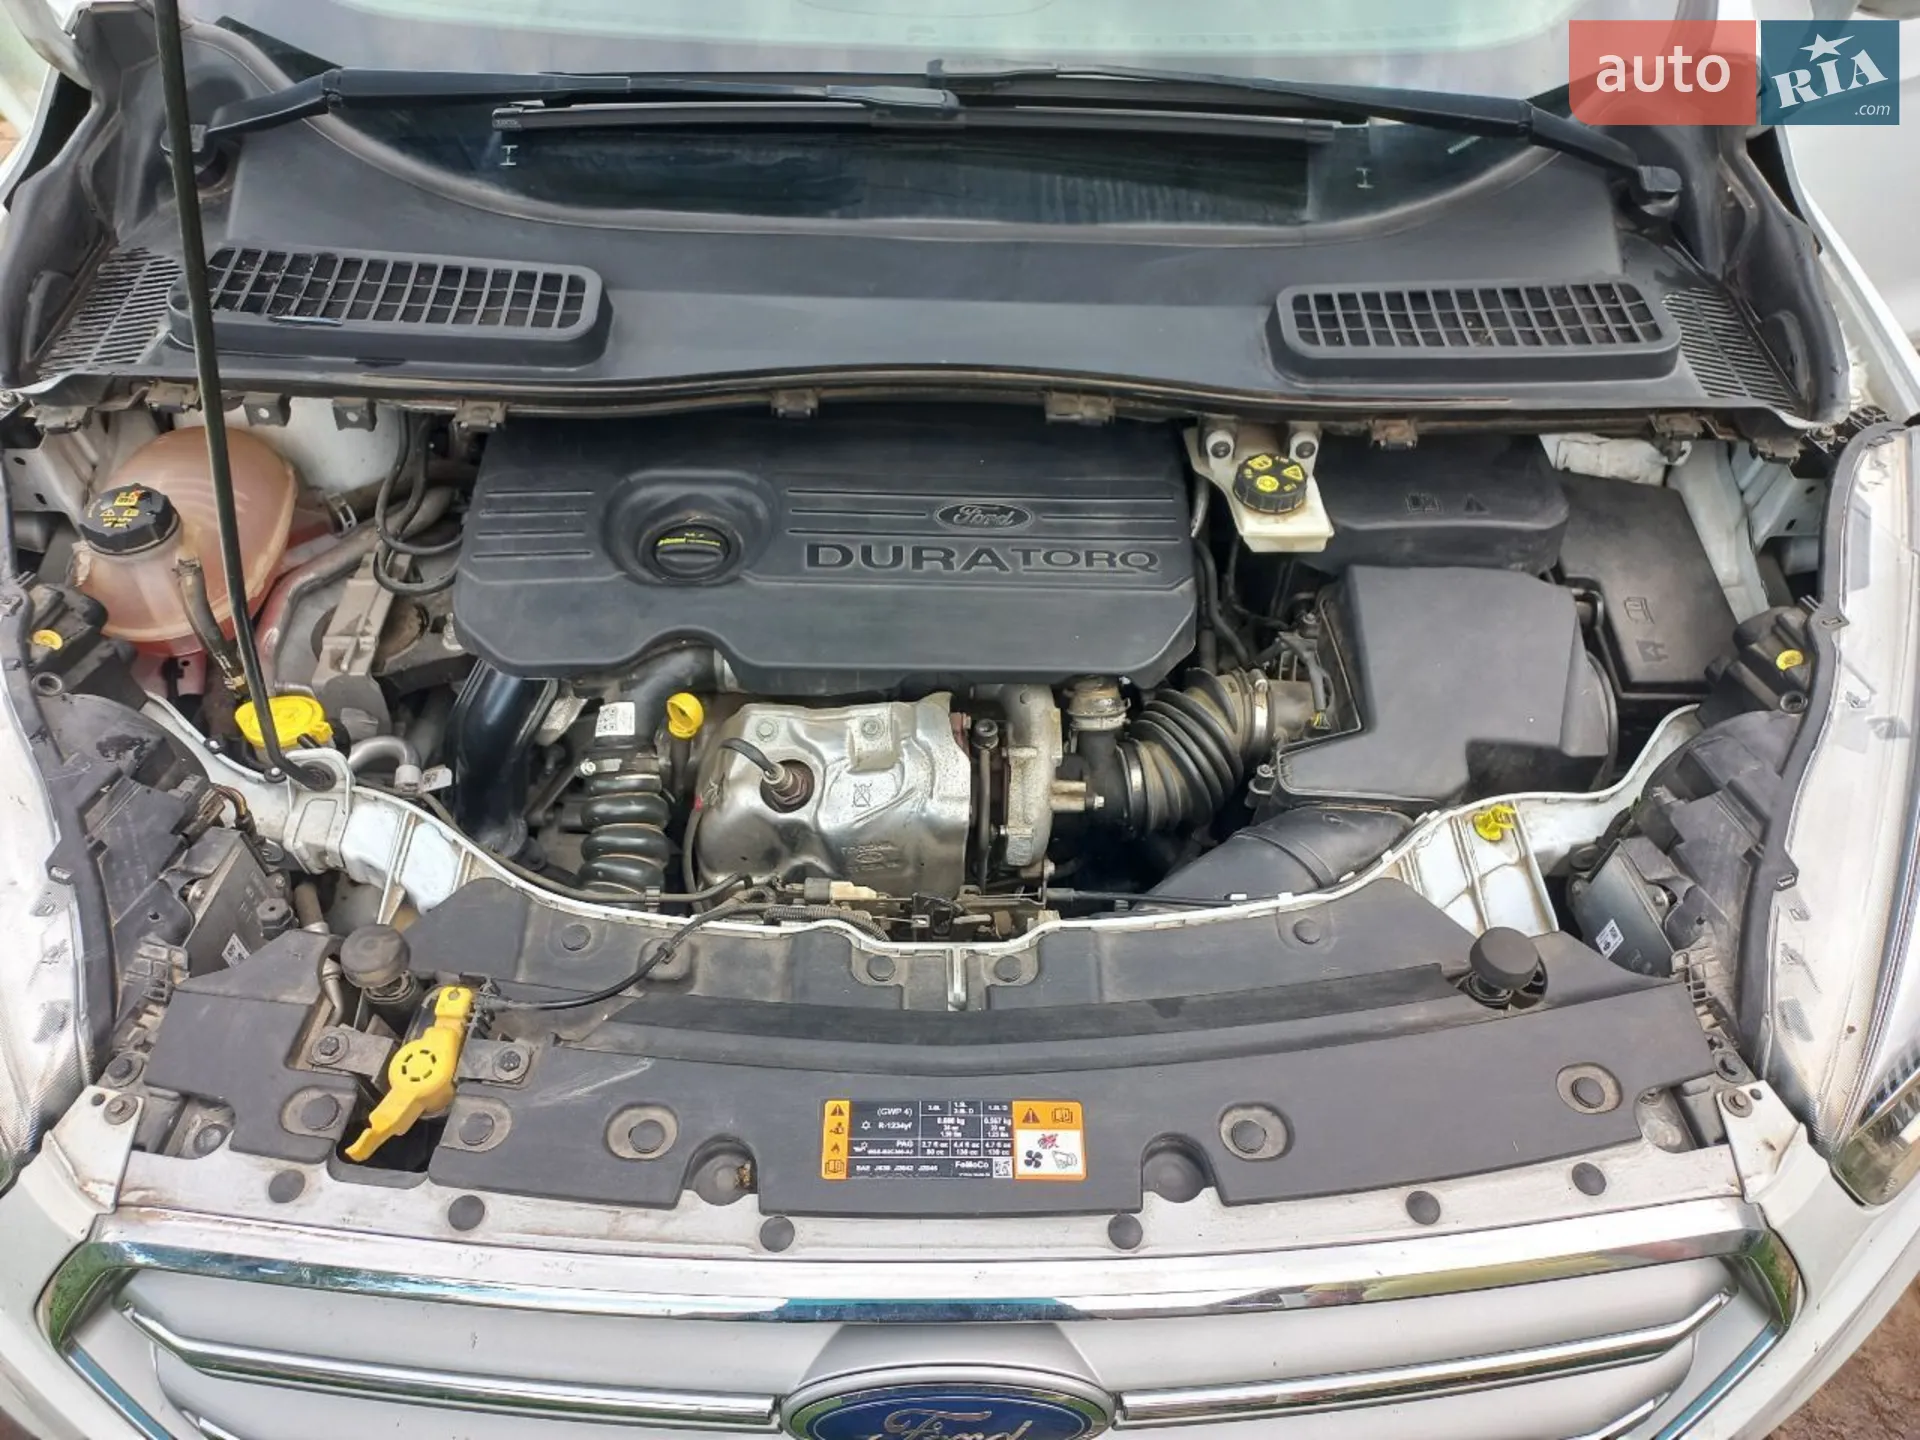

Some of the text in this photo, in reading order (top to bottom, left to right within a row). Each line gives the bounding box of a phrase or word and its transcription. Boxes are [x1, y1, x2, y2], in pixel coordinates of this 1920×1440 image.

[953, 504, 1015, 527] Ford
[804, 541, 1161, 575] DURATORQ
[876, 1107, 913, 1118] (GWP 4)
[878, 1121, 913, 1131] R-1234yf
[956, 1117, 965, 1126] kg
[1003, 1117, 1012, 1126] kg
[896, 1139, 914, 1148] PAG
[955, 1160, 989, 1168] FoMoCo
